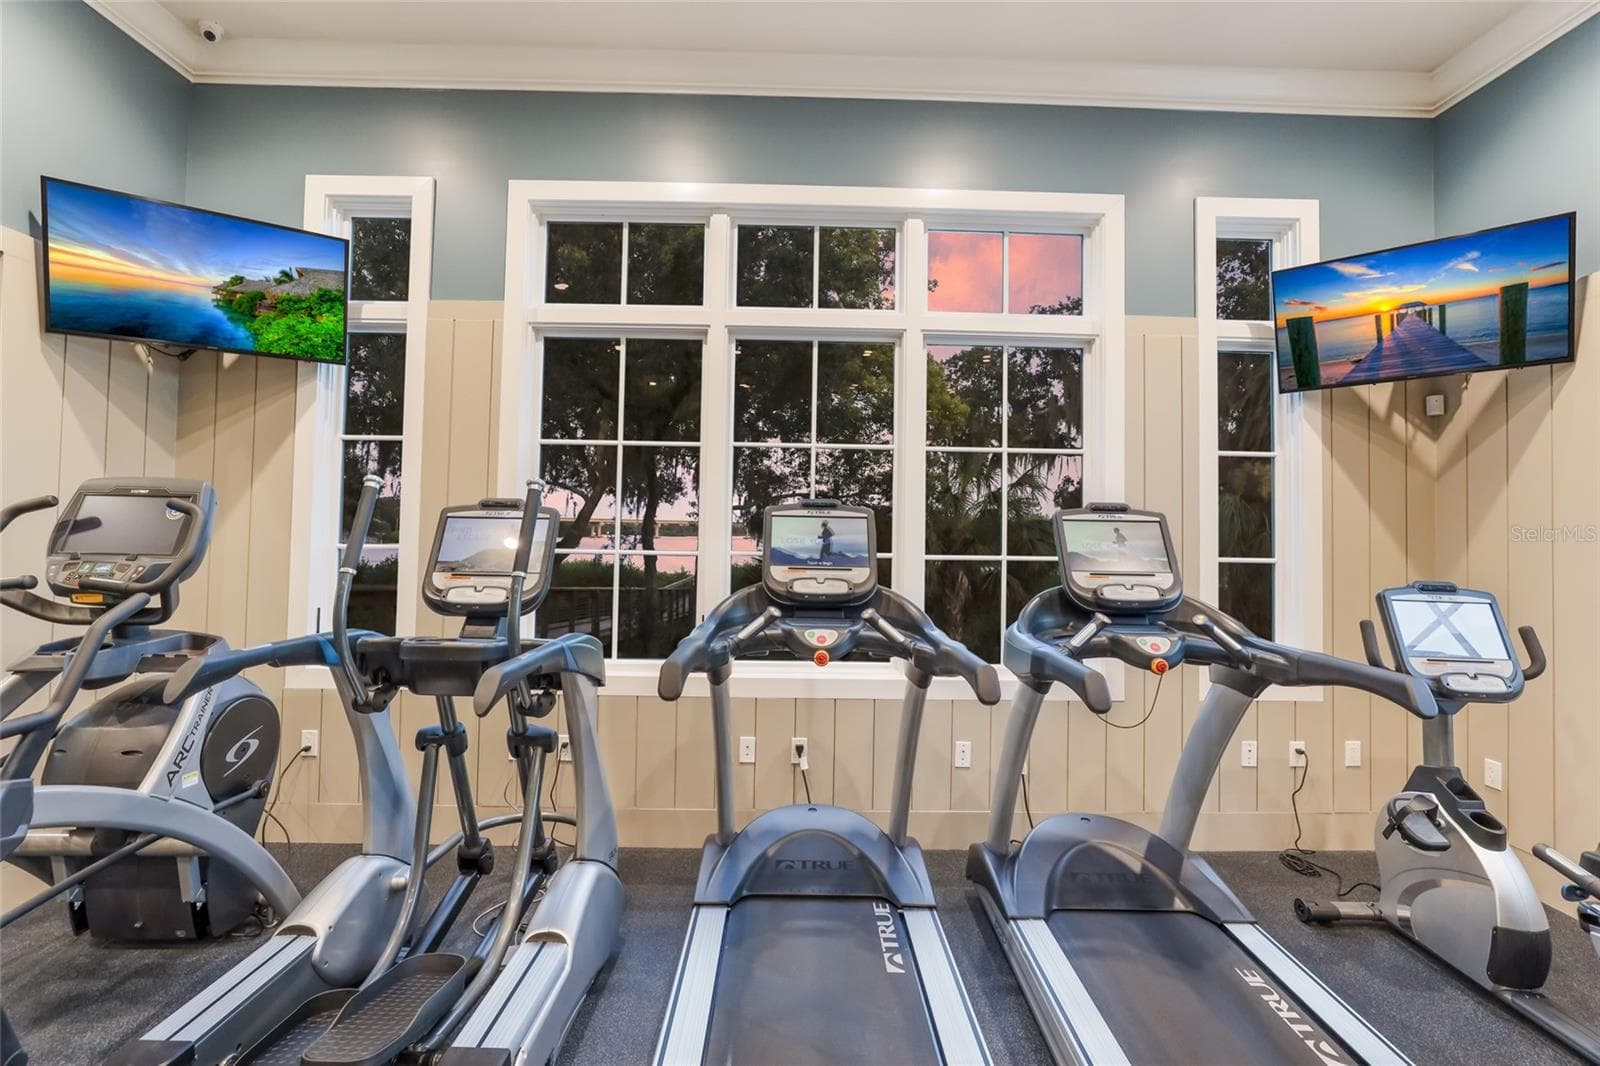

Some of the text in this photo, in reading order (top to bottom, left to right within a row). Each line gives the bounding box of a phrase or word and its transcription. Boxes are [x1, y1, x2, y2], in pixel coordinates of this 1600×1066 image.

[797, 859, 857, 871] TRUE
[873, 902, 899, 952] TRUE
[1234, 967, 1314, 1039] TRUE
